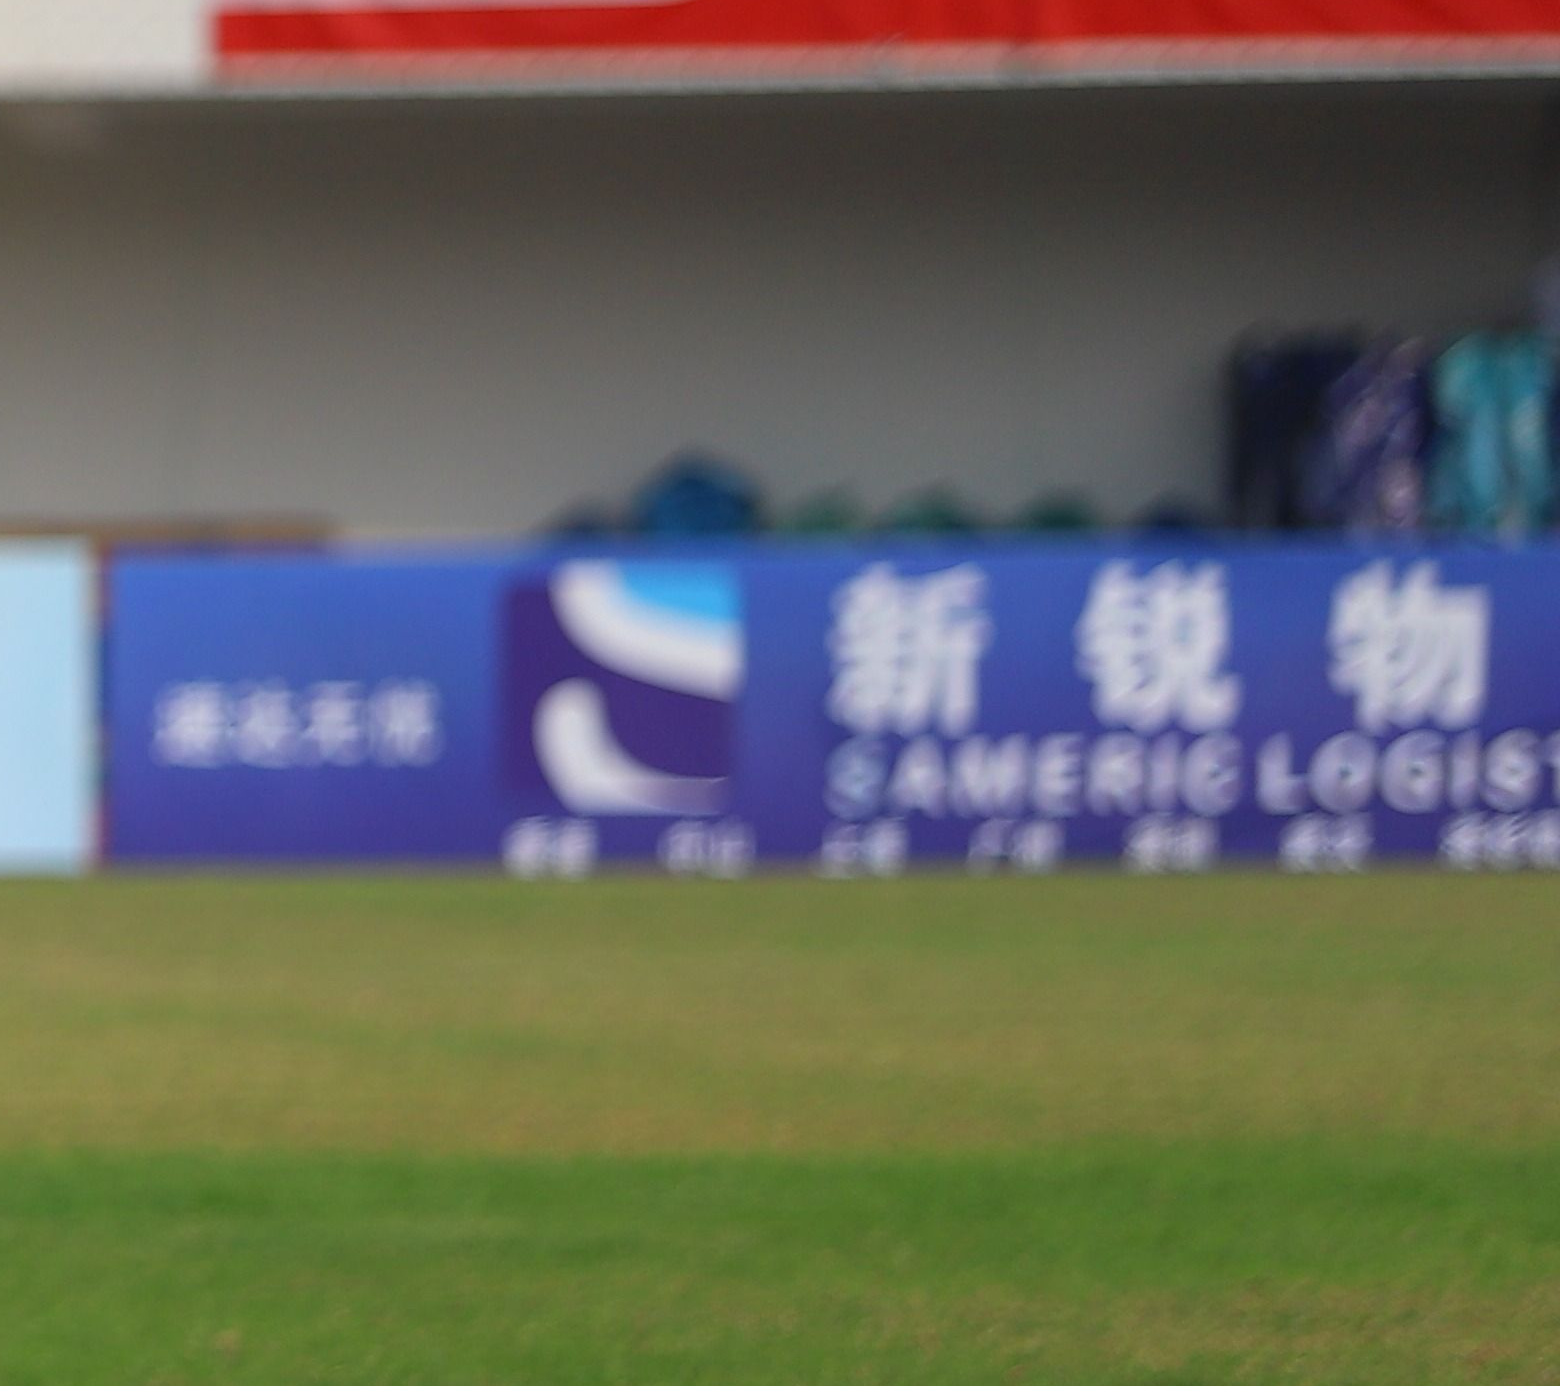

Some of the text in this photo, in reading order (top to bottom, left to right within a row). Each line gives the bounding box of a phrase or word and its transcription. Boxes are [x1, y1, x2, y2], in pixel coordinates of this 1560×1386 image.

[828, 560, 1492, 733] 新锐物
[1256, 730, 1560, 813] LOGIS
